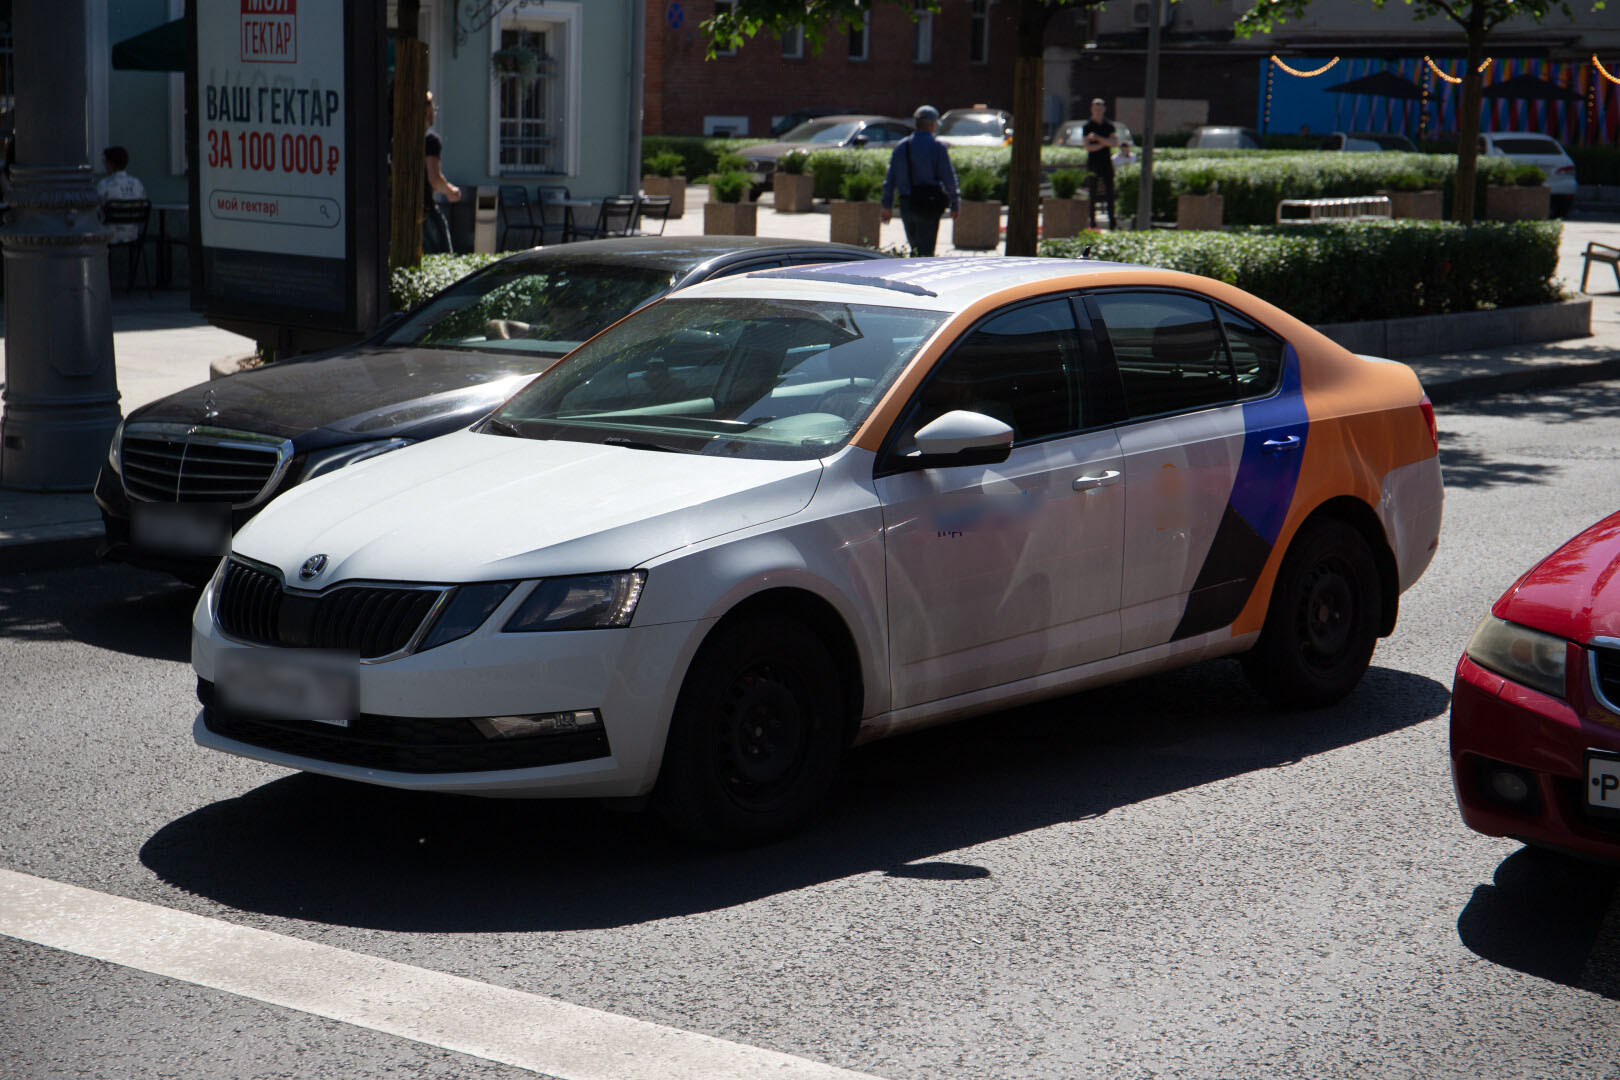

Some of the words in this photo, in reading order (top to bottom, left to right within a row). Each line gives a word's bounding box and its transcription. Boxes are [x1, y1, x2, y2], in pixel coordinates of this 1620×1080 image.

[244, 21, 292, 55] ГЕКТАР
[207, 85, 250, 123] ВАШ
[258, 87, 339, 127] ГЕКТАР
[208, 129, 233, 169] ЗА
[238, 132, 276, 171] 100
[281, 134, 323, 174] 000
[217, 198, 238, 211] мой
[241, 202, 276, 216] гектар
